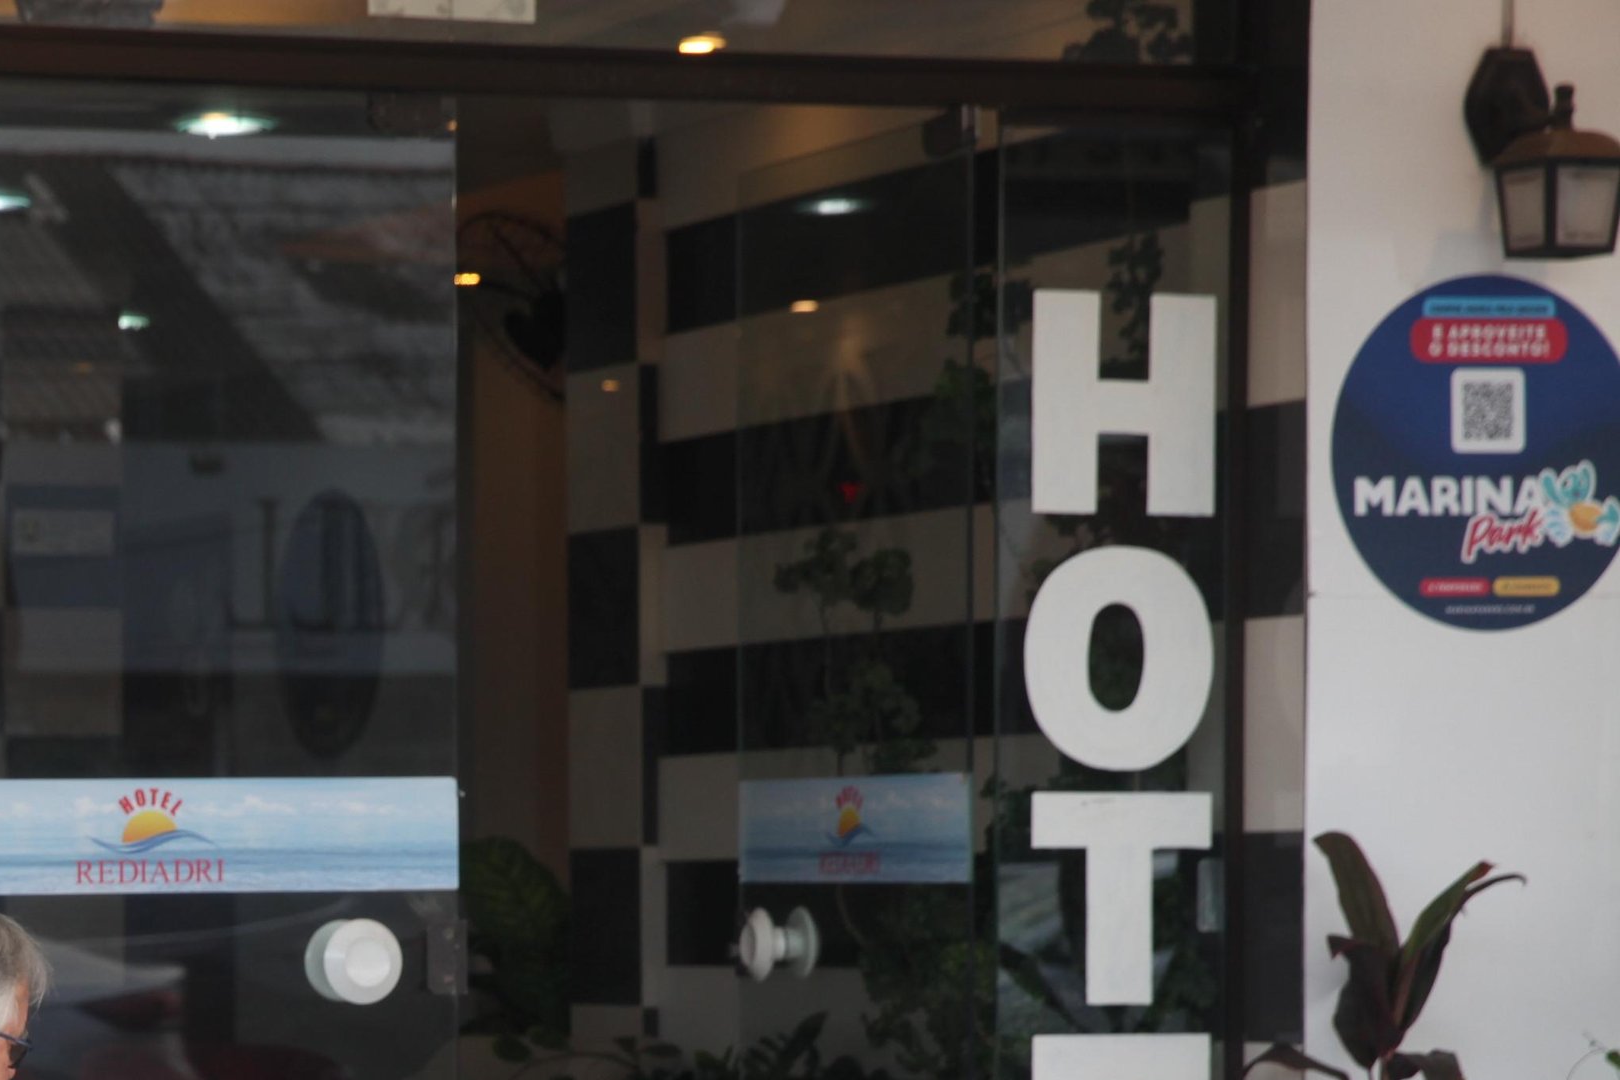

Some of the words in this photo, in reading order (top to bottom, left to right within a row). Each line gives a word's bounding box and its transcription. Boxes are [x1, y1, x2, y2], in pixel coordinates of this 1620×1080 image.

[1353, 475, 1542, 517] MARINA
[1461, 510, 1543, 562] Park
[118, 787, 184, 816] HOTEL
[75, 858, 225, 886] REDIADRI
